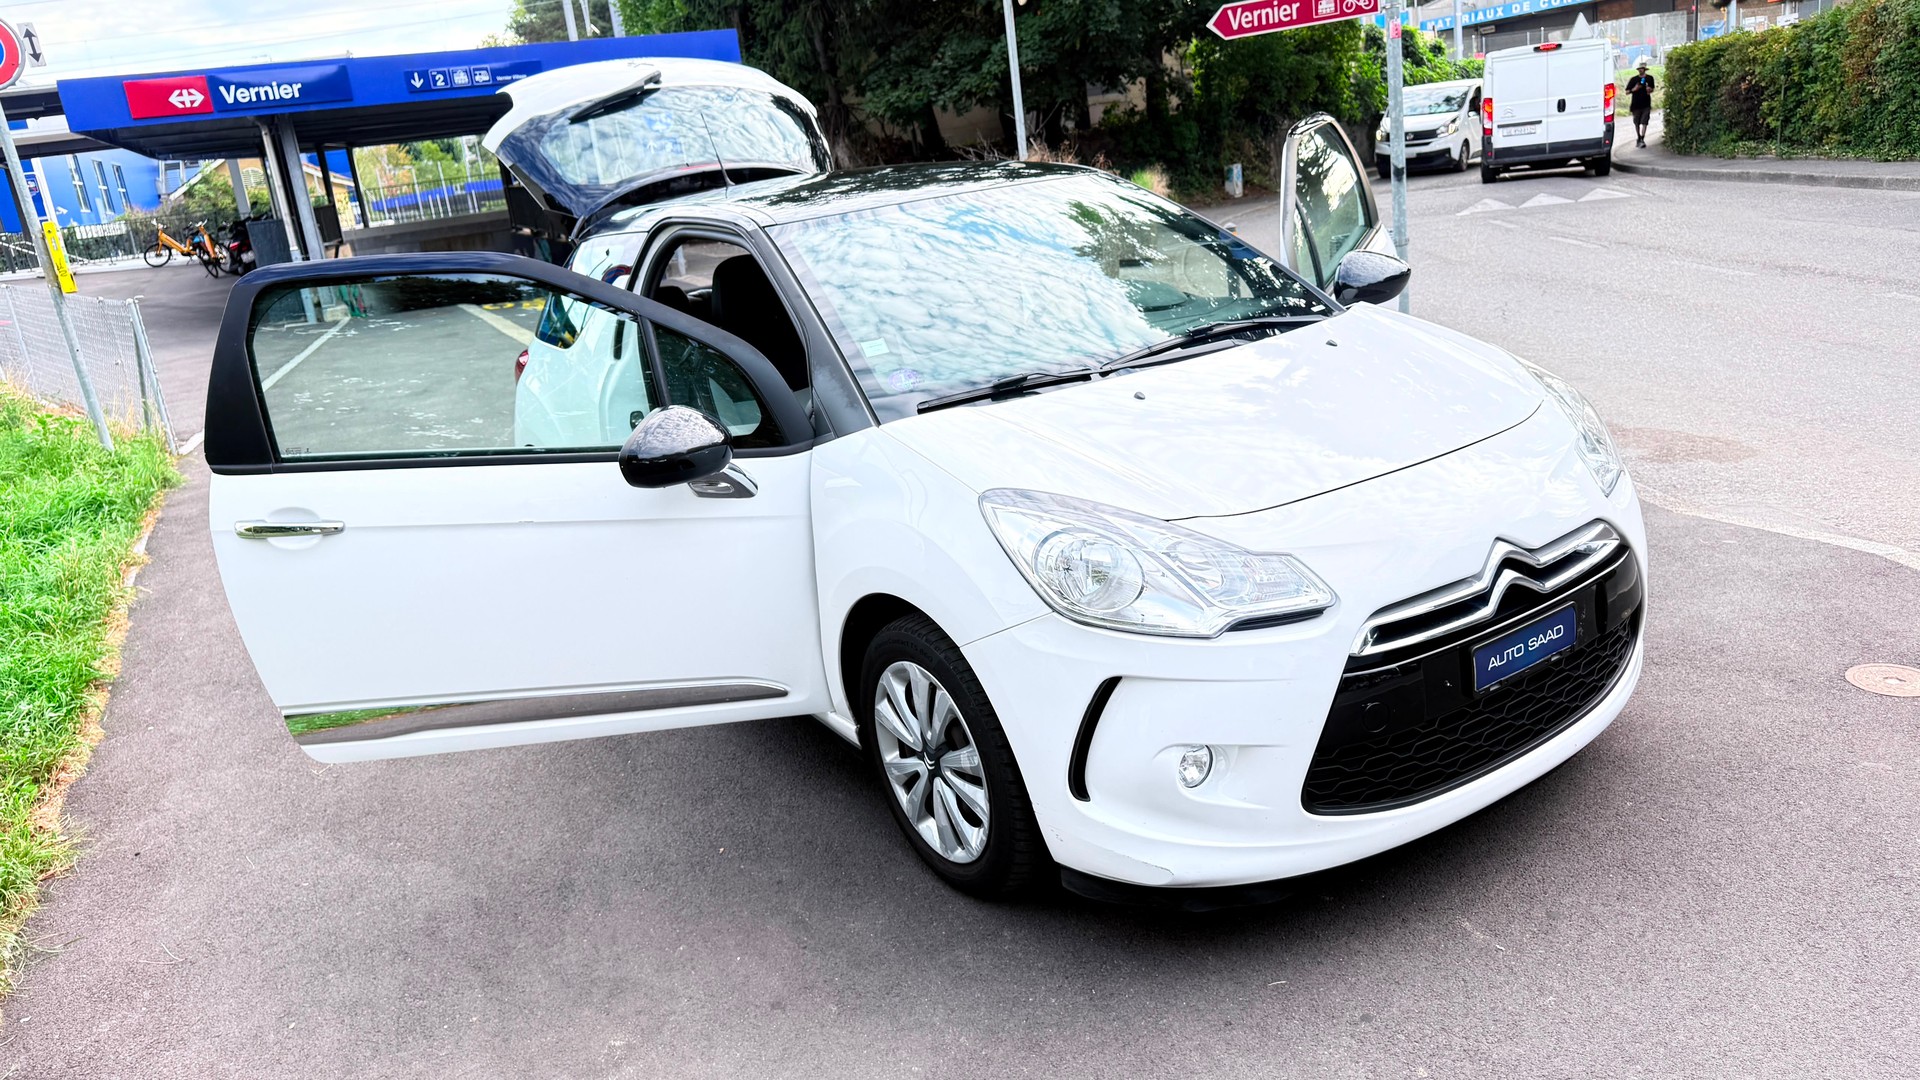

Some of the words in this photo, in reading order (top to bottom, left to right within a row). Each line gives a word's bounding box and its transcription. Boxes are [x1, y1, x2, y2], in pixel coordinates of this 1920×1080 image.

[1227, 1, 1300, 30] Vernier
[1426, 6, 1504, 31] MATRIAUX
[1511, 1, 1531, 14] DE
[219, 81, 302, 104] Vernier
[435, 73, 445, 86] 2
[1488, 643, 1524, 671] AUTO
[1528, 624, 1564, 651] SAAD
